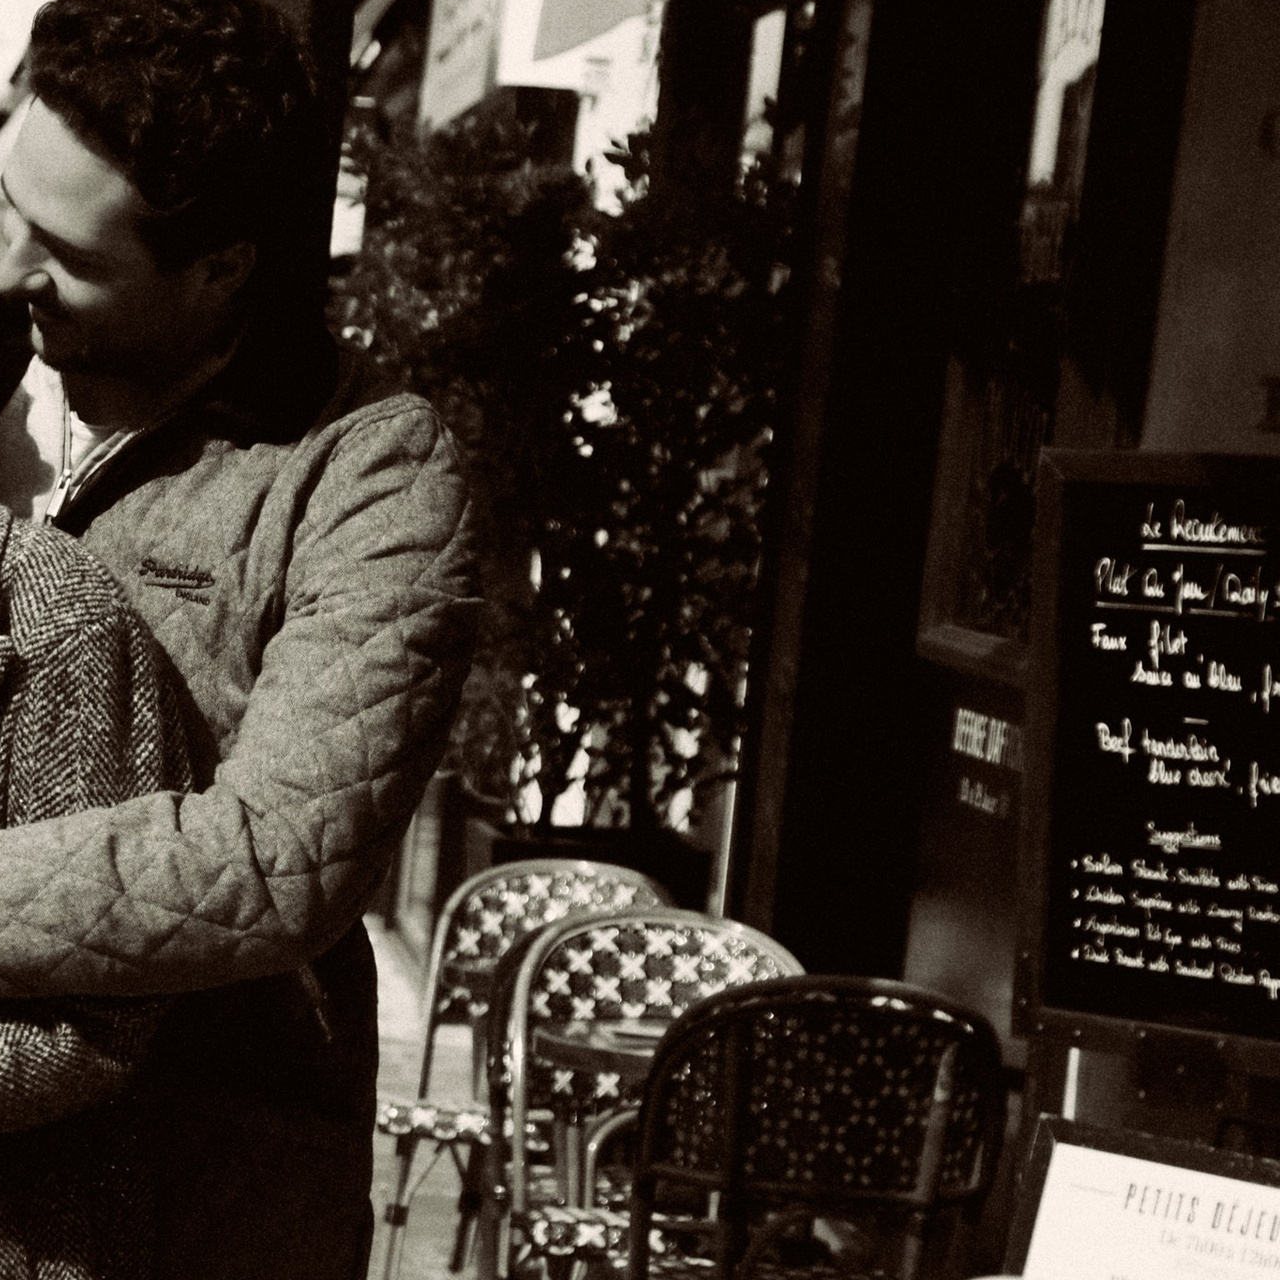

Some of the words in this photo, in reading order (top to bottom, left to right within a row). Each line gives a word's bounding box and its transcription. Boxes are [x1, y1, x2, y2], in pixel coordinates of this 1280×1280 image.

[176, 588, 210, 606] ENGLAND
[1094, 557, 1138, 596] Plat
[1224, 565, 1269, 622] Daily
[1090, 622, 1127, 650] Faux
[1183, 671, 1201, 689] au
[1095, 717, 1137, 764] Beef
[1147, 757, 1182, 784] blue
[1144, 820, 1221, 854] Suggestions
[1226, 873, 1250, 891] with
[1084, 885, 1126, 905] Chicken
[1177, 898, 1200, 915] with
[1189, 933, 1212, 949] with
[1083, 944, 1110, 964] Duck
[1147, 954, 1169, 972] with
[1123, 1183, 1199, 1224] PETITS
